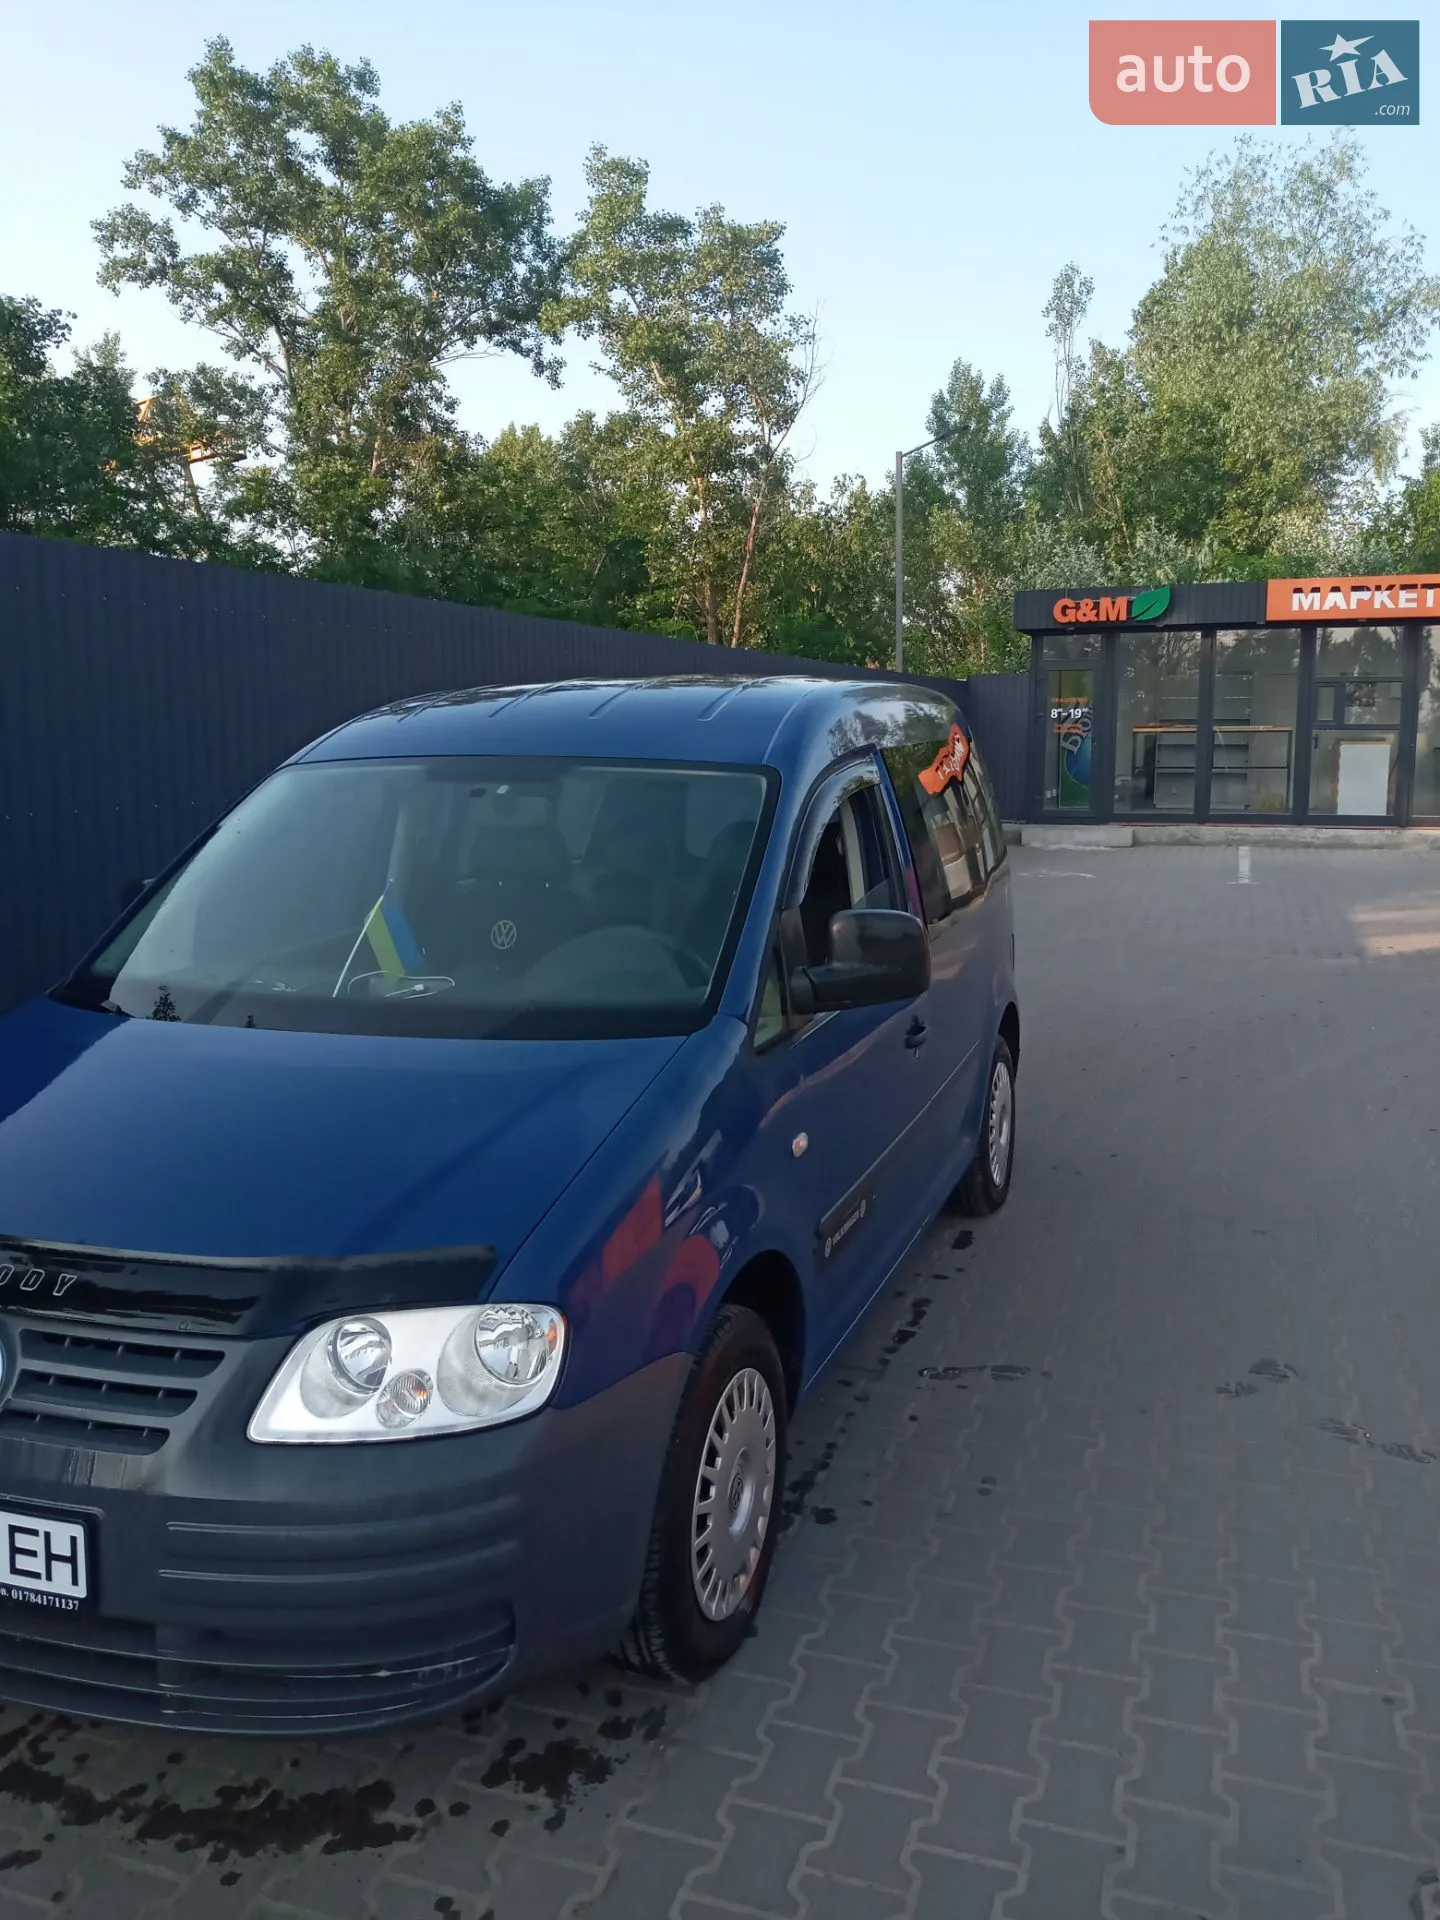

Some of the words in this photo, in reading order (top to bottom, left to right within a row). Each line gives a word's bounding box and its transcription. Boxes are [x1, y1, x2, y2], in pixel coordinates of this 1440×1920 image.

[1053, 597, 1128, 623] G&M
[1292, 583, 1440, 611] МАРКЕТ
[8, 1523, 79, 1587] EH
[11, 1588, 80, 1611] 01784171137
